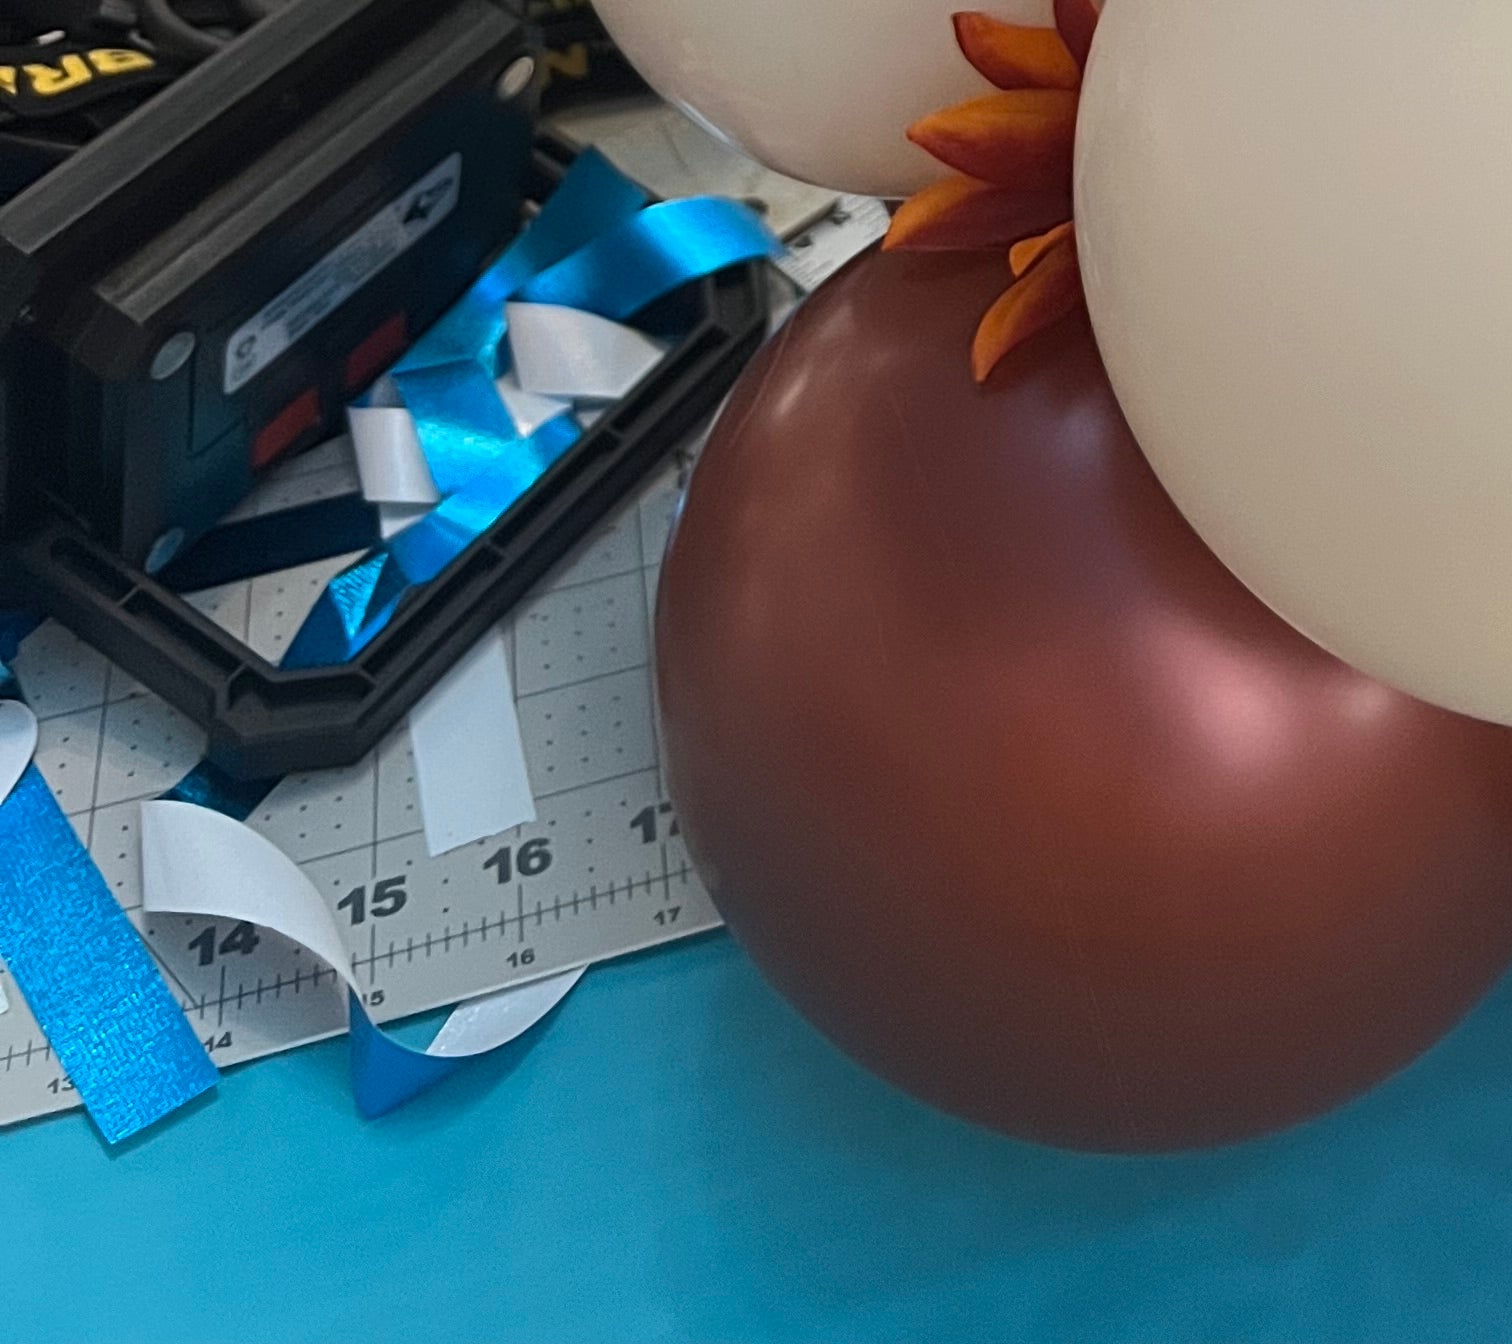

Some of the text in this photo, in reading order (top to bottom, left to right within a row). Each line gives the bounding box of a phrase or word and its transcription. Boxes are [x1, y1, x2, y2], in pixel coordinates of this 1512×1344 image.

[188, 920, 260, 966] 14
[337, 875, 407, 926] 15
[482, 837, 553, 885] 16
[204, 1031, 233, 1053] 14
[506, 948, 536, 968] 16
[653, 906, 682, 926] 17
